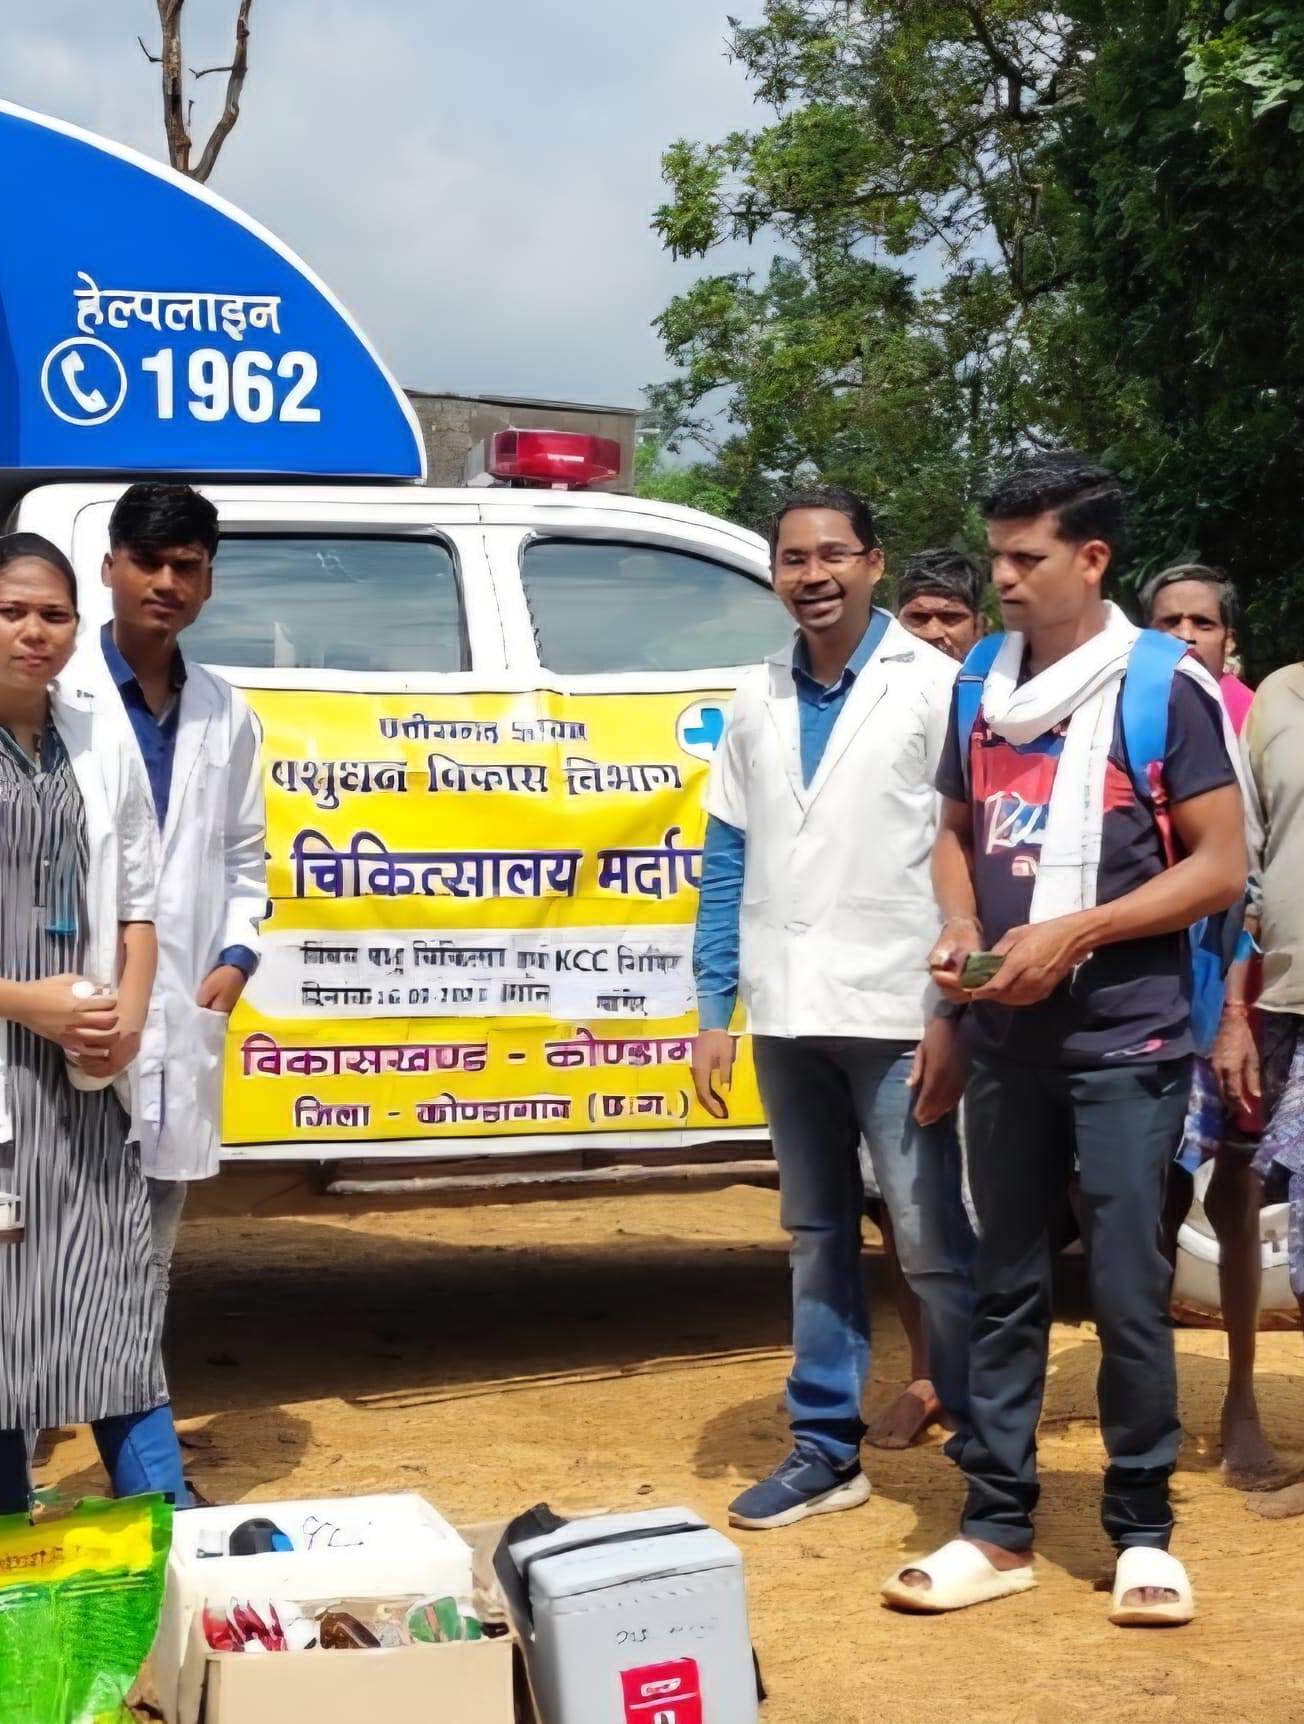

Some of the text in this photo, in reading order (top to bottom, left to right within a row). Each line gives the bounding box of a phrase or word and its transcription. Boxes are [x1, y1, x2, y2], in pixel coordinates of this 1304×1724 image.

[73, 271, 281, 341] हेल्पलाइन
[142, 348, 321, 423] 1962
[428, 753, 548, 792] विकास
[565, 756, 684, 795] विभाग
[289, 829, 583, 898] चिकित्सालय
[555, 949, 608, 972] KCC
